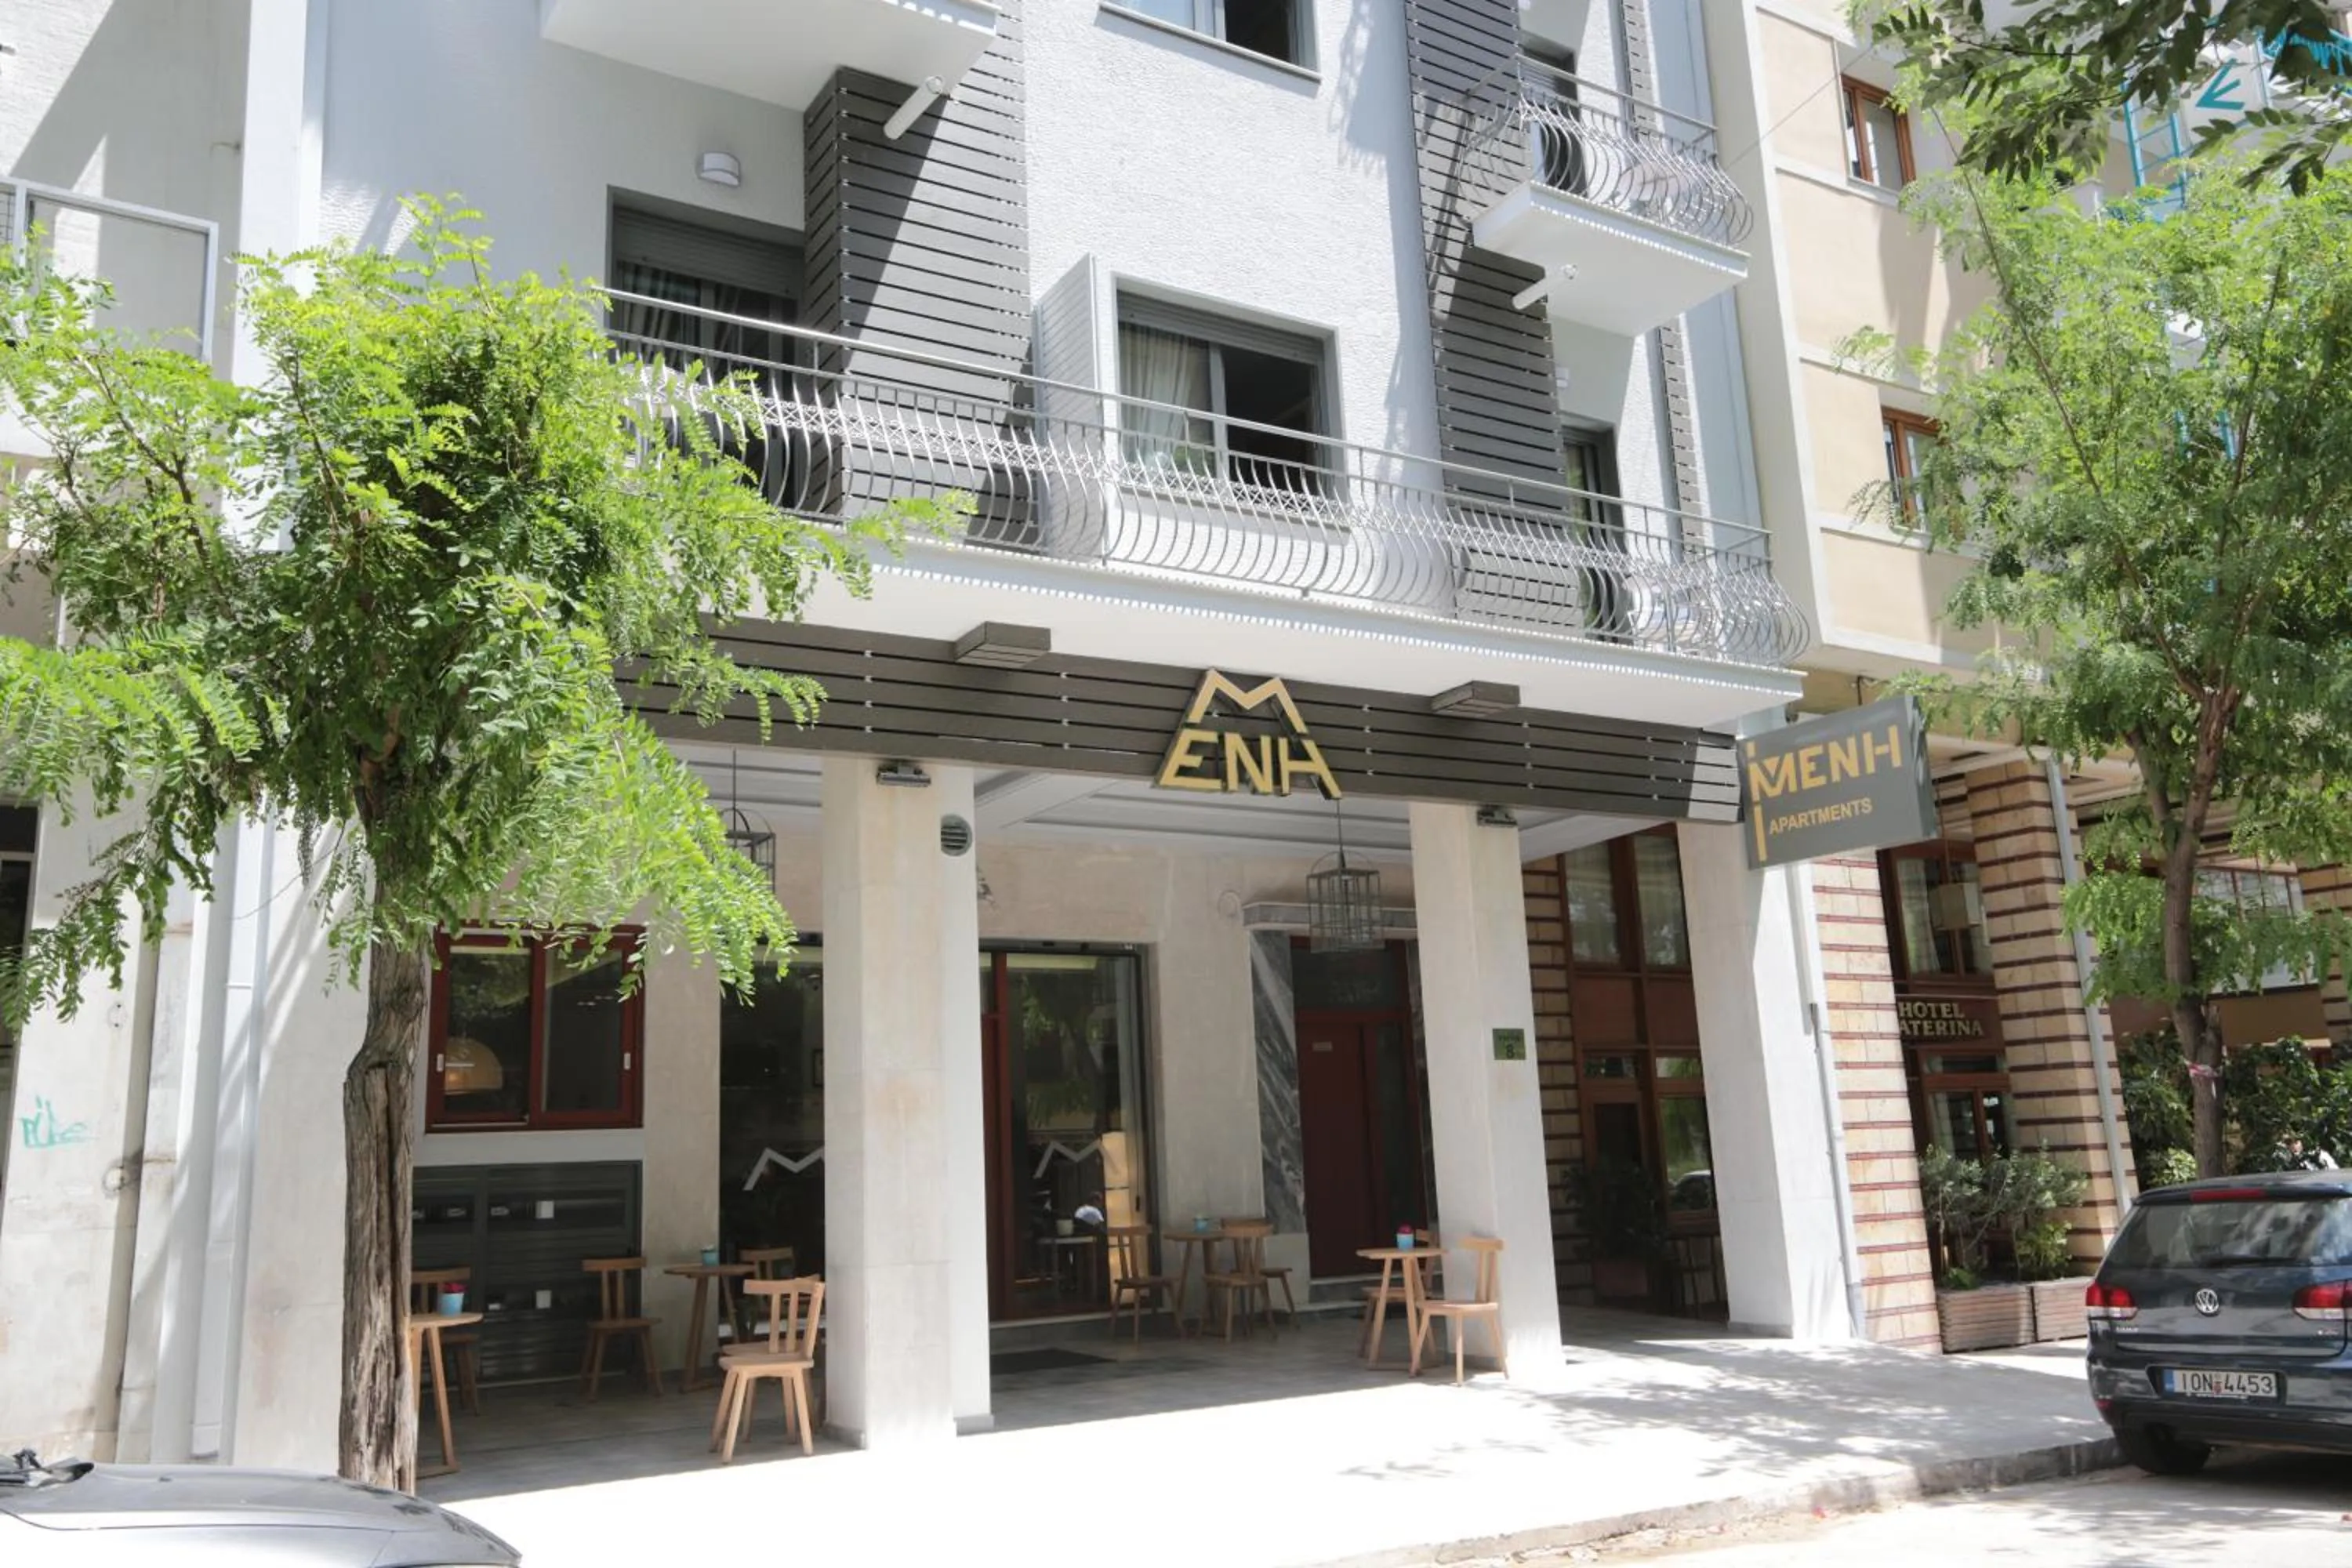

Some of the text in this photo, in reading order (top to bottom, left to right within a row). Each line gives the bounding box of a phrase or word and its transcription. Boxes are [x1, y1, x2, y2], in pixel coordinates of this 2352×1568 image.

[1769, 798, 1872, 835] APARTMENTS
[1898, 1001, 1965, 1018] HOTEL
[1900, 1020, 1984, 1036] ATERINA
